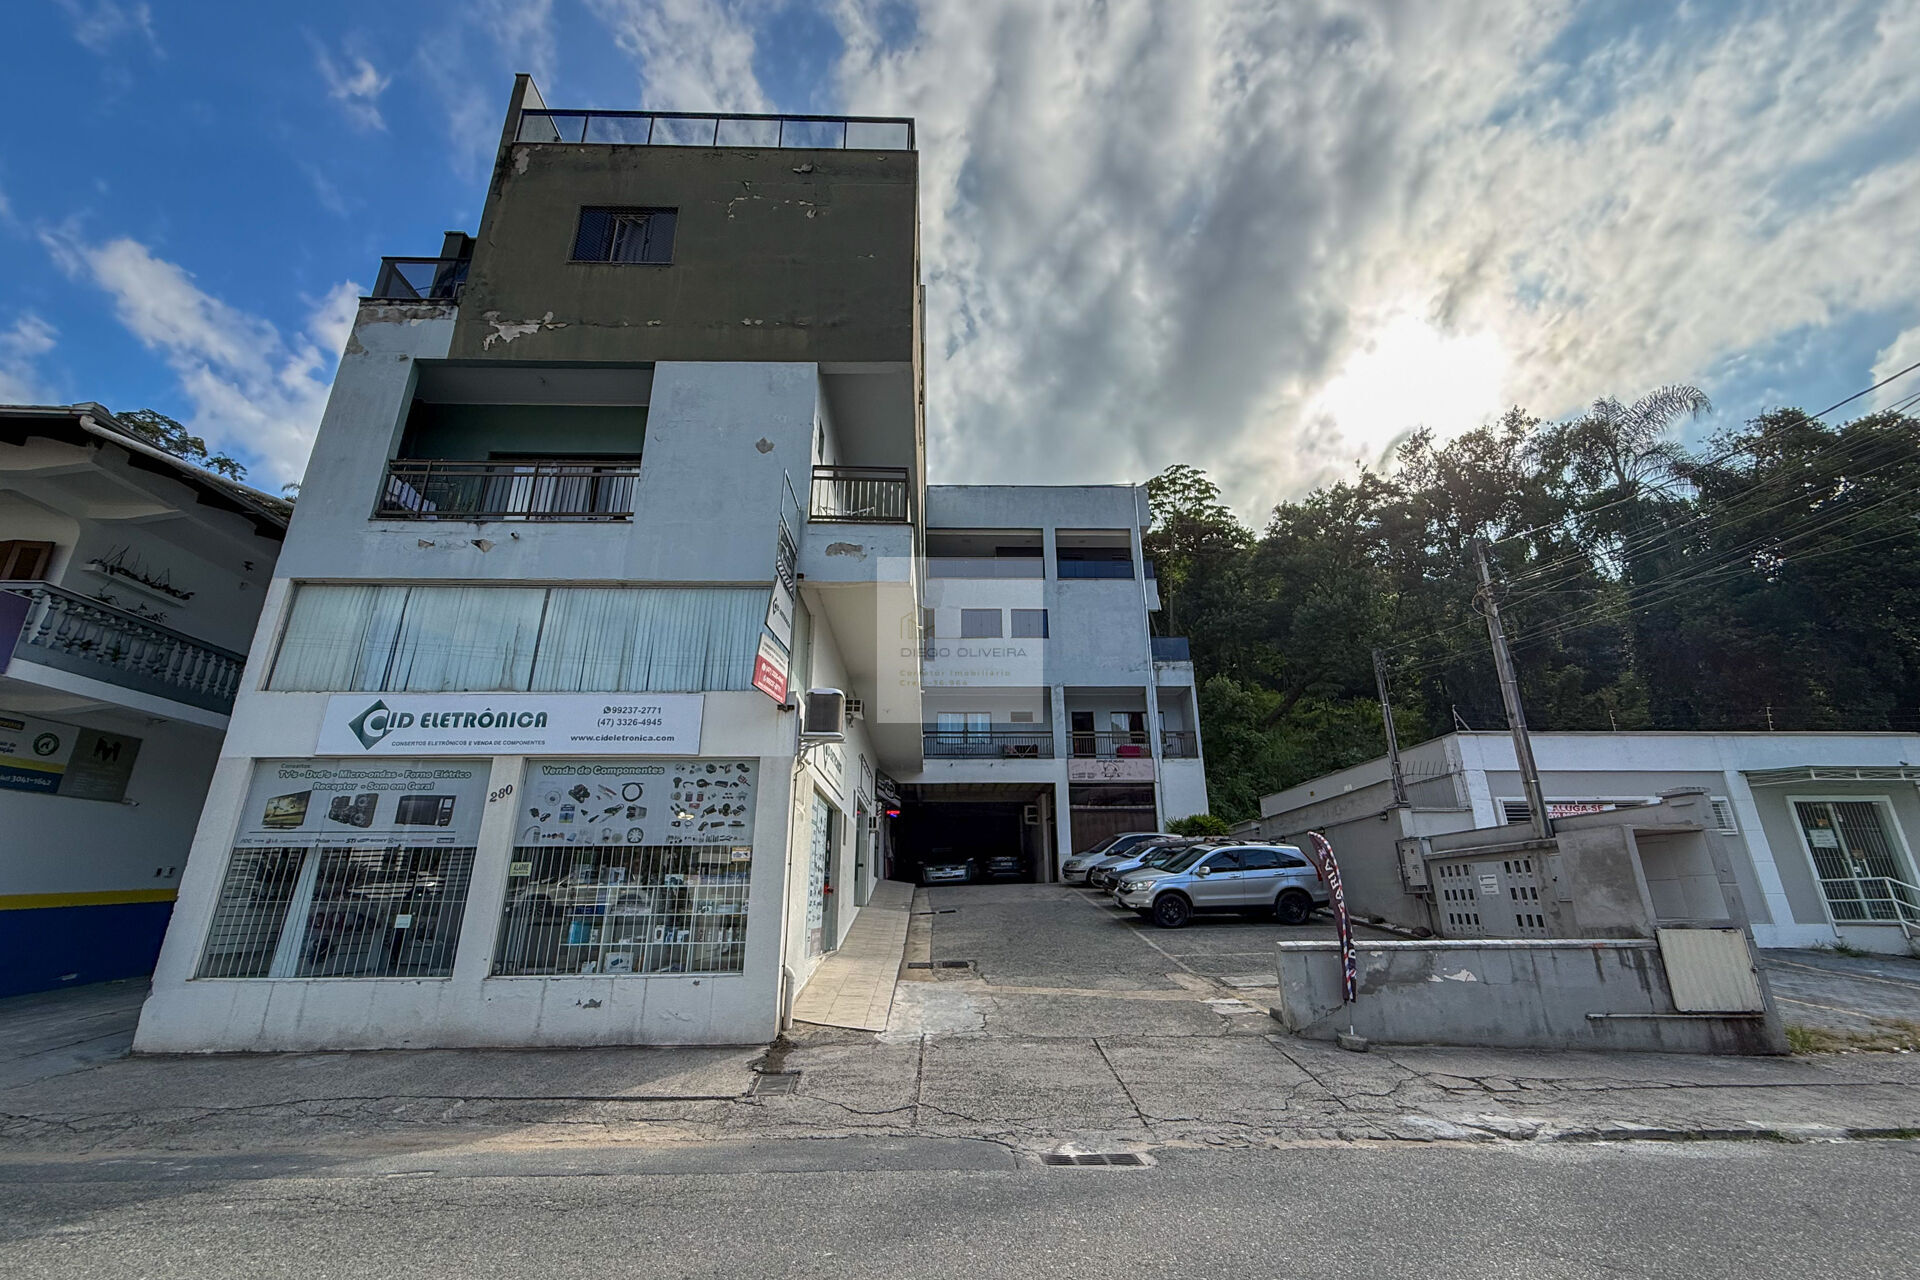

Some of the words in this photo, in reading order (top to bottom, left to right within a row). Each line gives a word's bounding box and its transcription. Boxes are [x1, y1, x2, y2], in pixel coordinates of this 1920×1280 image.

[612, 706, 662, 714] 99237-2771
[420, 707, 549, 729] ELETRÔNICA
[597, 718, 614, 727] (47)
[617, 718, 663, 726] 3326-4945
[278, 769, 299, 779] Tv's
[305, 769, 332, 779] Dvd's
[338, 769, 398, 779] Micro-ondas
[404, 769, 433, 779] Forno
[433, 769, 472, 779] Elétrico
[543, 766, 576, 775] Venda
[577, 766, 591, 775] de
[592, 766, 665, 776] Componentes
[312, 782, 358, 792] Receptor
[367, 782, 389, 791] Som
[390, 783, 405, 791] em
[406, 782, 435, 791] Geral
[489, 784, 514, 802] 280
[1552, 804, 1604, 812] ALUGA-SE
